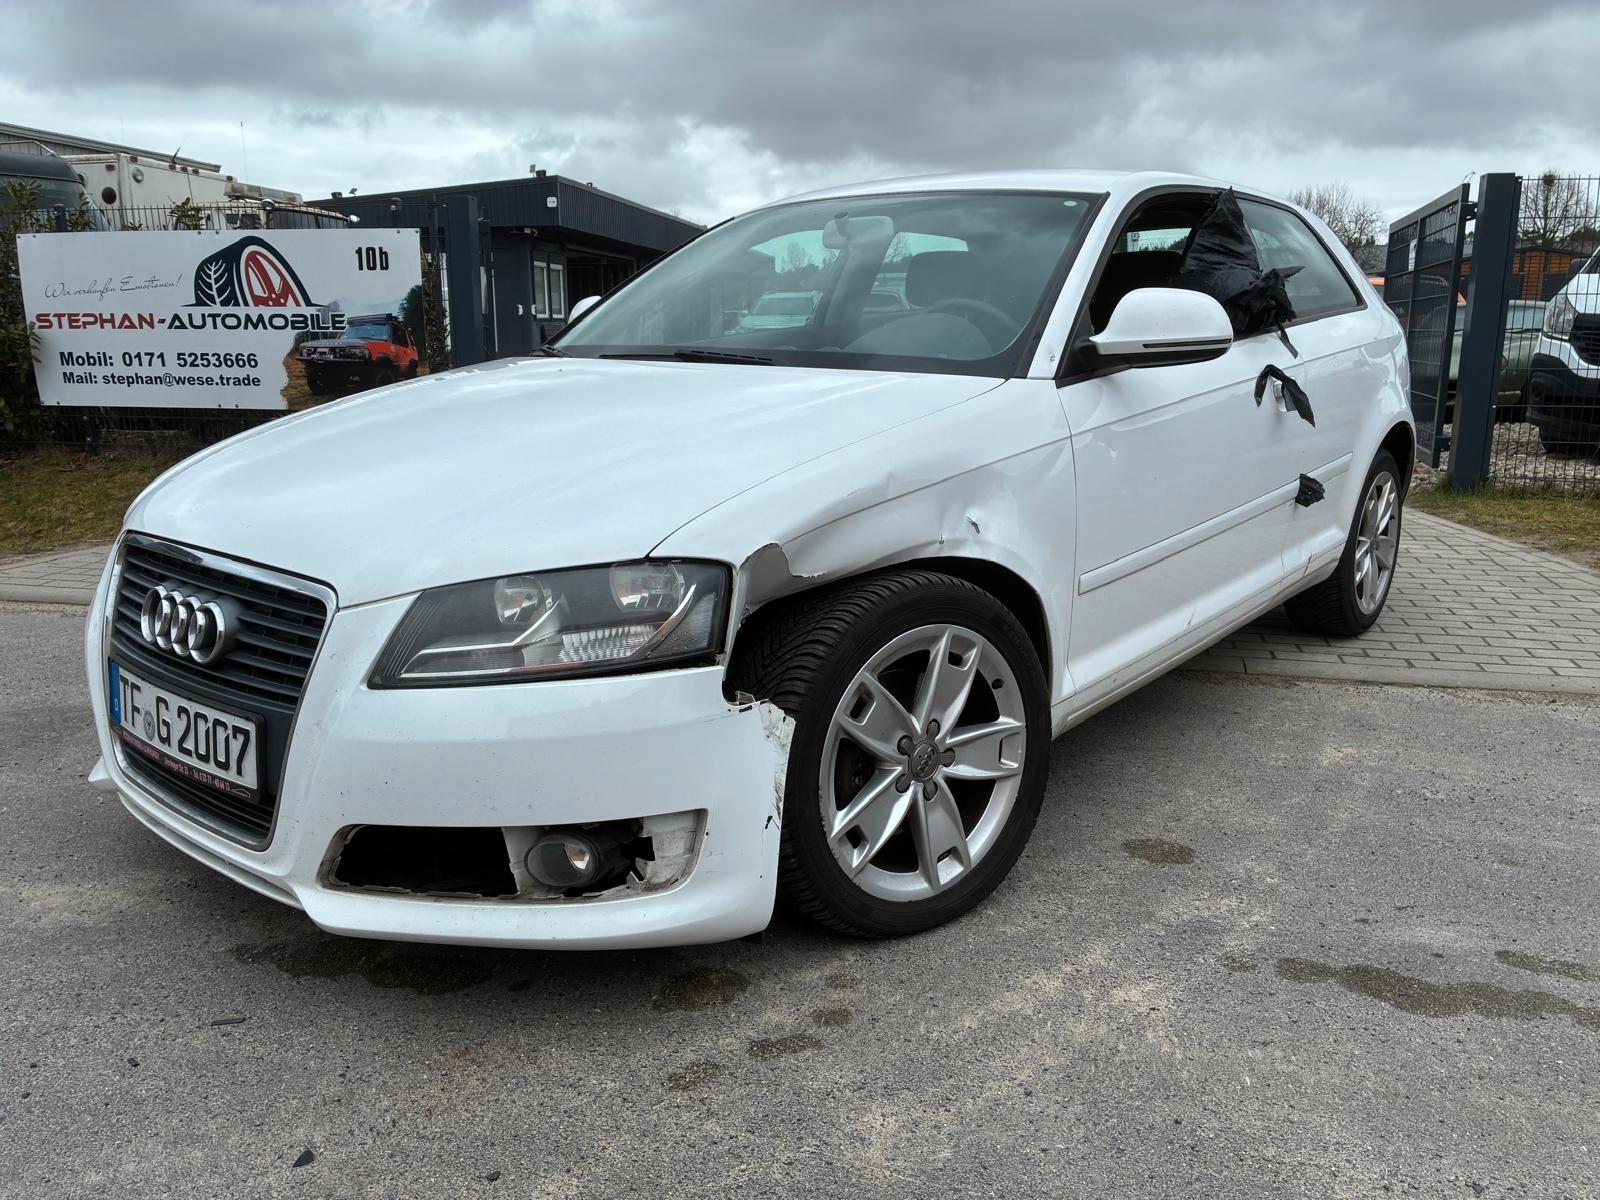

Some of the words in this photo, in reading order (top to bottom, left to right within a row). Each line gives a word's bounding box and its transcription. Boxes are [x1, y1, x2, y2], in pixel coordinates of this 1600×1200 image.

[355, 246, 389, 271] 10b
[44, 282, 71, 298] Wir
[119, 273, 183, 292] Emotionen!
[35, 312, 349, 331] STEPHAN-AUTOMOBILE
[59, 351, 114, 367] Mobil:
[122, 352, 166, 368] 0171
[176, 352, 259, 368] 5253666
[62, 372, 98, 384] Mail:
[102, 372, 261, 387] stephan@wese.trade
[119, 673, 142, 728] TF
[155, 695, 172, 748] G
[176, 704, 251, 777] 2007
